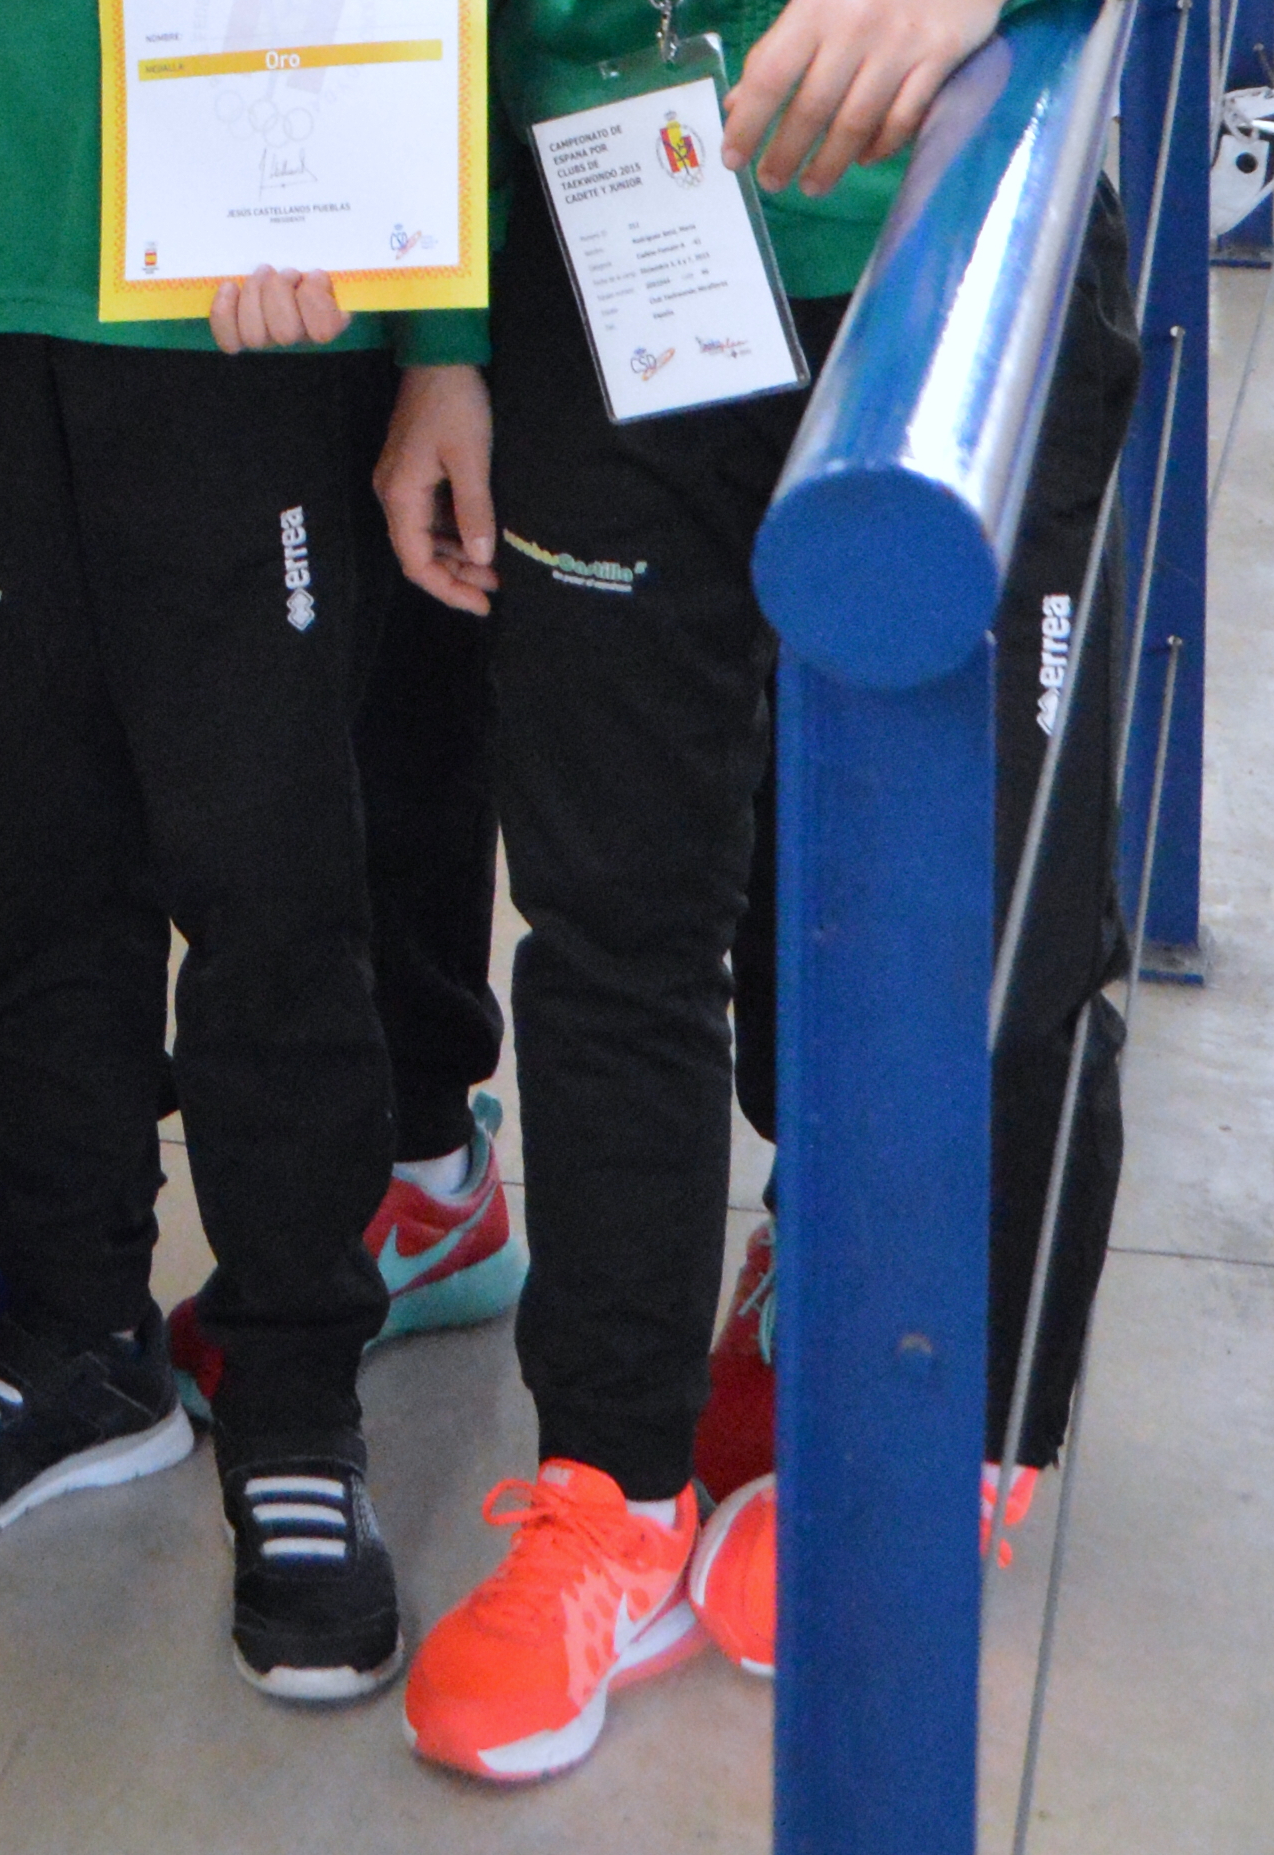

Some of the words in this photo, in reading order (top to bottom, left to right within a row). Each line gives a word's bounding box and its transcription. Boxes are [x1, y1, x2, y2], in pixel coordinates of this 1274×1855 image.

[265, 50, 301, 70] Oro
[549, 129, 609, 152] CAMPEONATO
[610, 124, 622, 136] DE
[589, 143, 607, 155] POR
[557, 163, 586, 178] CLUBS
[587, 160, 599, 170] DE
[562, 169, 617, 191] TAEKWONDO
[619, 162, 641, 176] 2015
[565, 187, 598, 204] CADETE
[609, 176, 642, 192] JUNIOR
[279, 506, 309, 590] errea
[1039, 594, 1072, 688] errea
